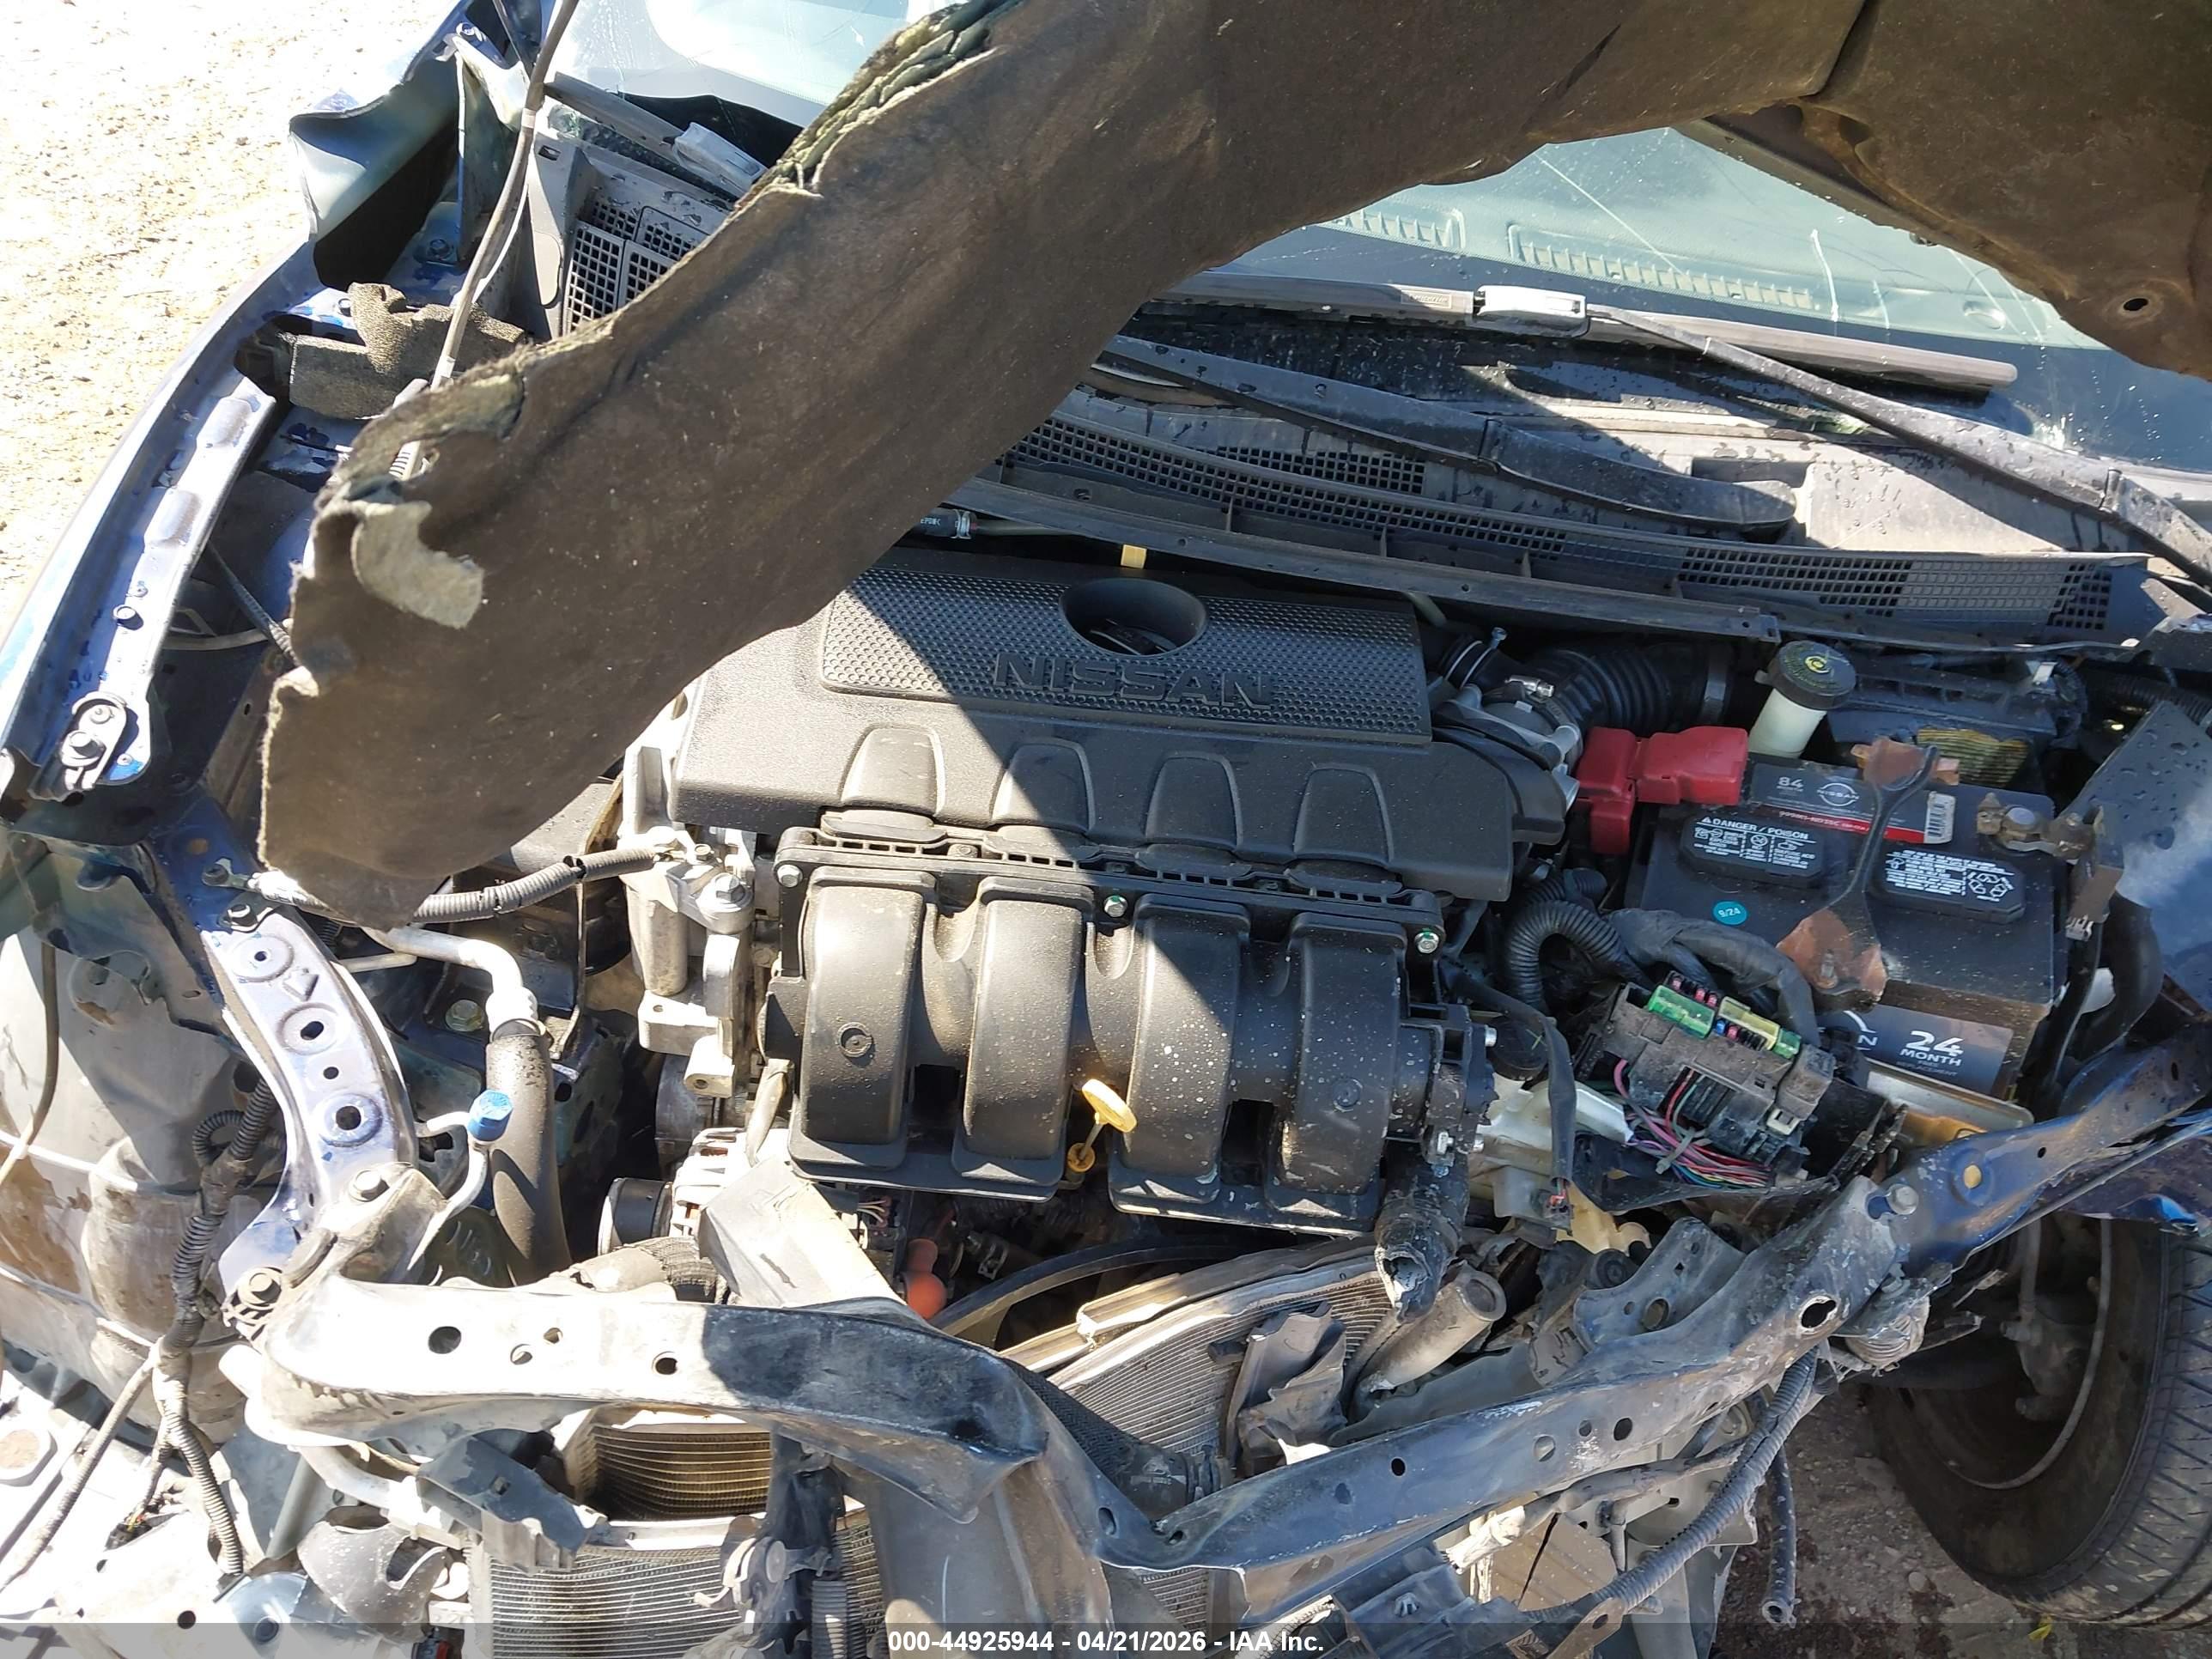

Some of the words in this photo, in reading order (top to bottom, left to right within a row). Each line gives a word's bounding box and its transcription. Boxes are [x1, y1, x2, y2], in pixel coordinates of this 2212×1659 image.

[993, 652, 1273, 710] NISSAN
[1778, 776, 1803, 788] 84
[1816, 789, 1860, 800] NISSAN
[1712, 817, 1758, 831] DANGER
[1767, 827, 1809, 840] POISON
[1905, 1030, 1965, 1057] 24
[1899, 1048, 1963, 1066] MONTH
